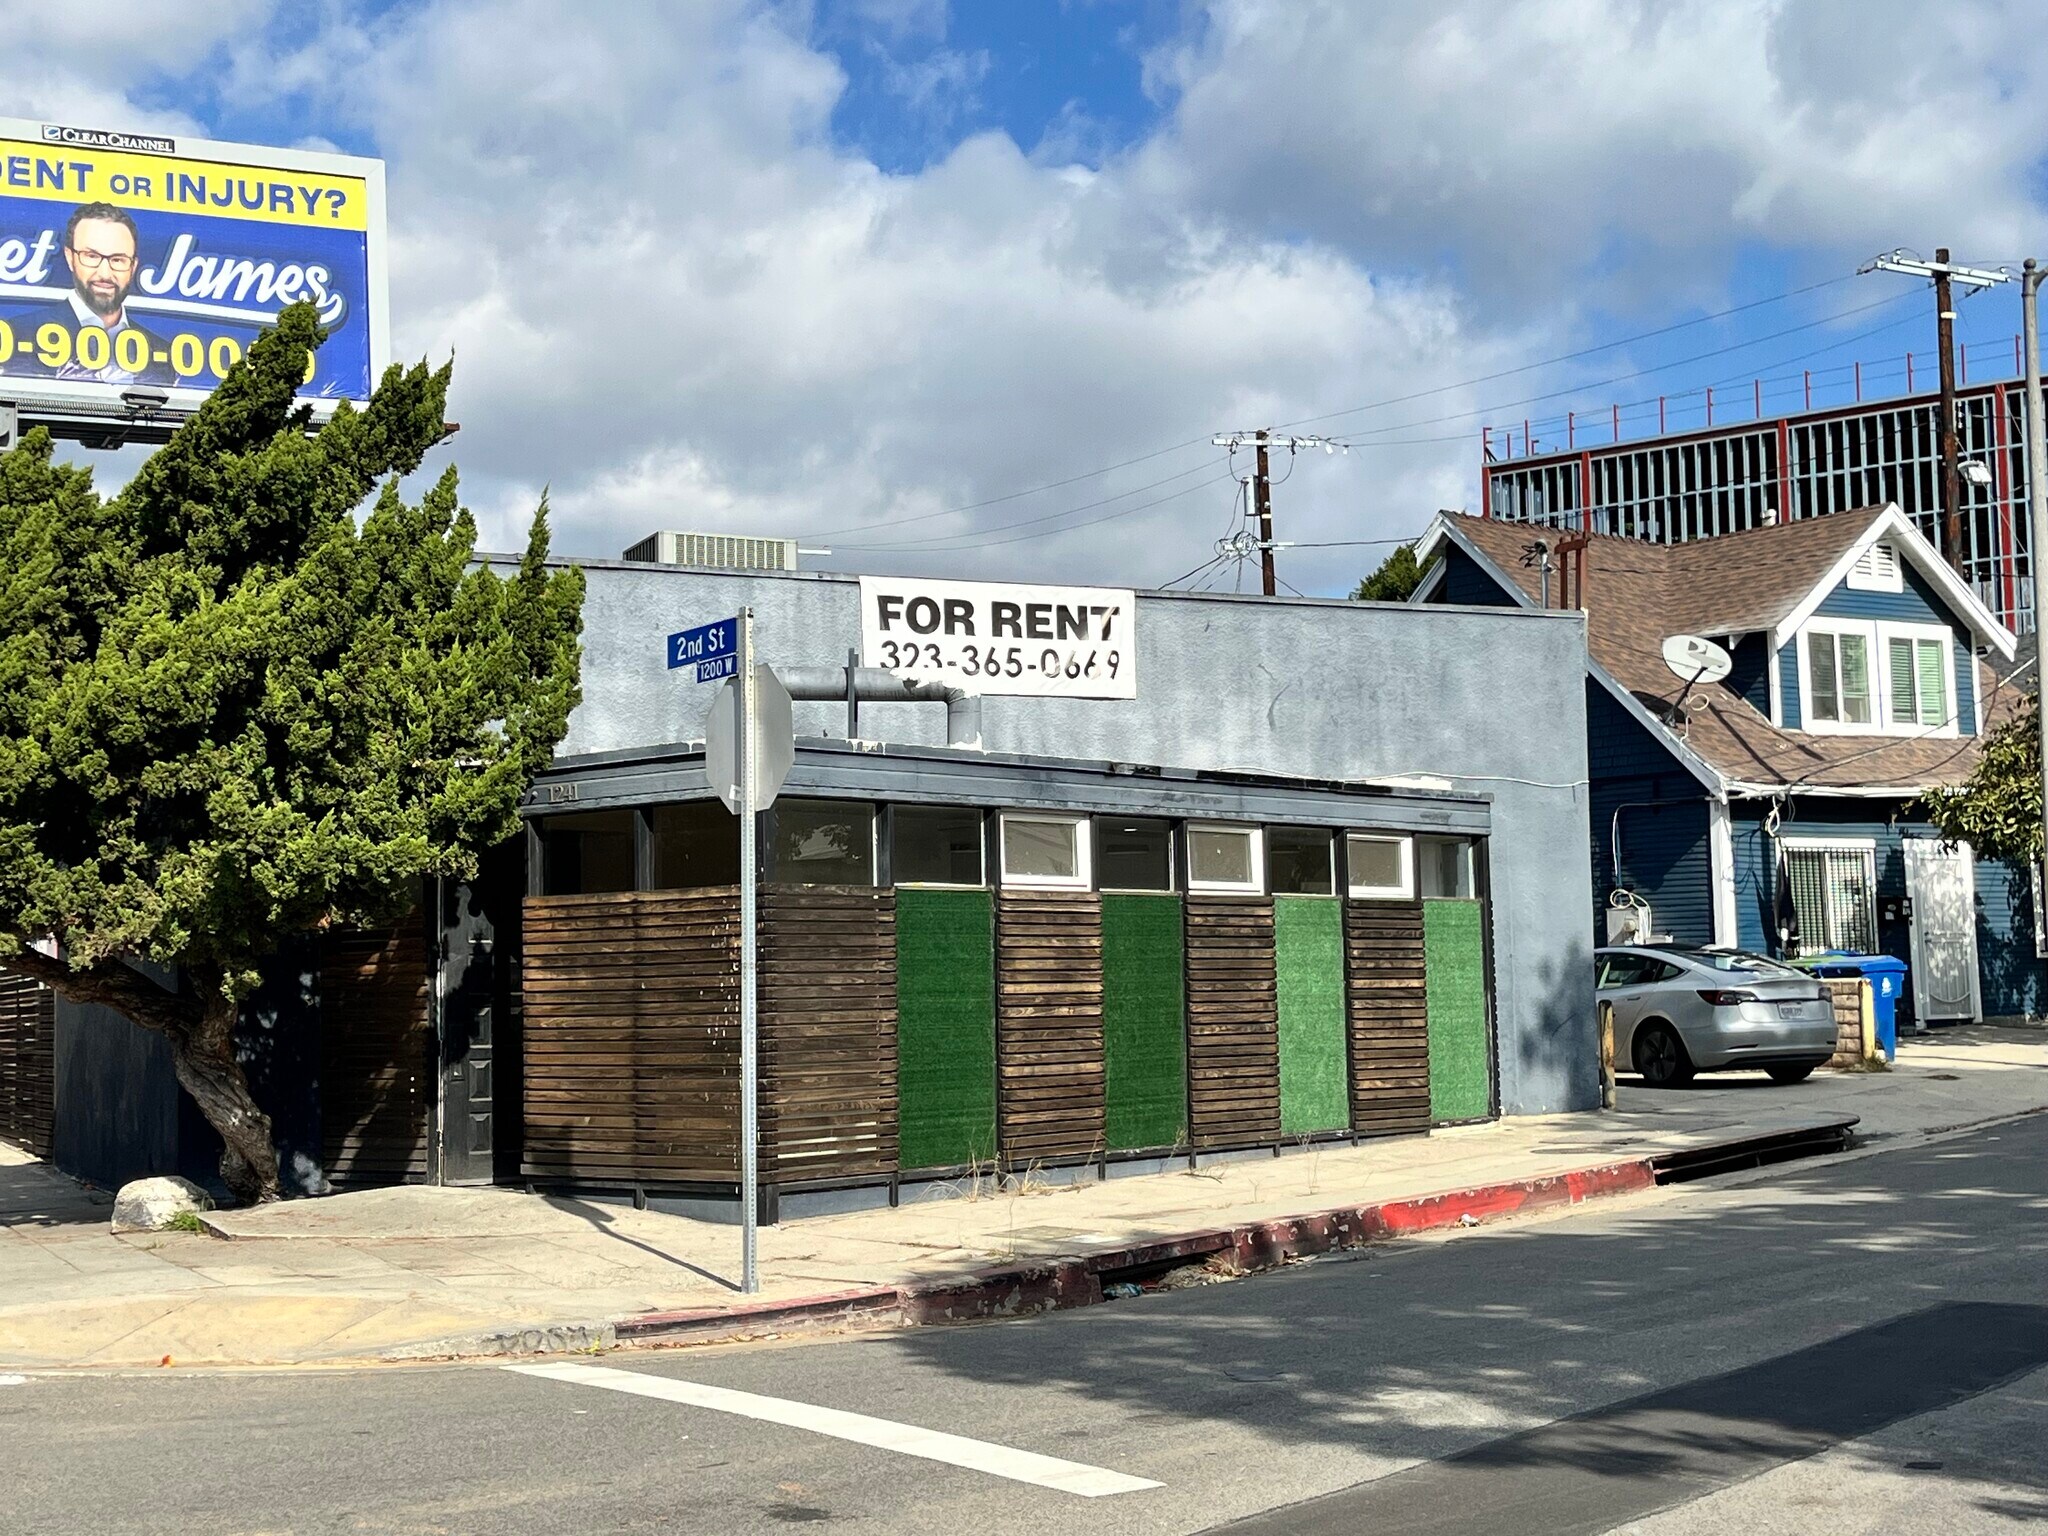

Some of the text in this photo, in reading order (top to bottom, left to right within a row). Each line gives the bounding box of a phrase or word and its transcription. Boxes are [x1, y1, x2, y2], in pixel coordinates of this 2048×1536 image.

[0, 156, 347, 218] ENT OR INJURY?
[139, 233, 343, 323] James
[877, 595, 1121, 641] FOR RENT
[676, 627, 726, 660] 2nd St
[879, 640, 1120, 679] 323-365-0669
[700, 657, 733, 680] 1200 W
[548, 782, 580, 803] 1241
